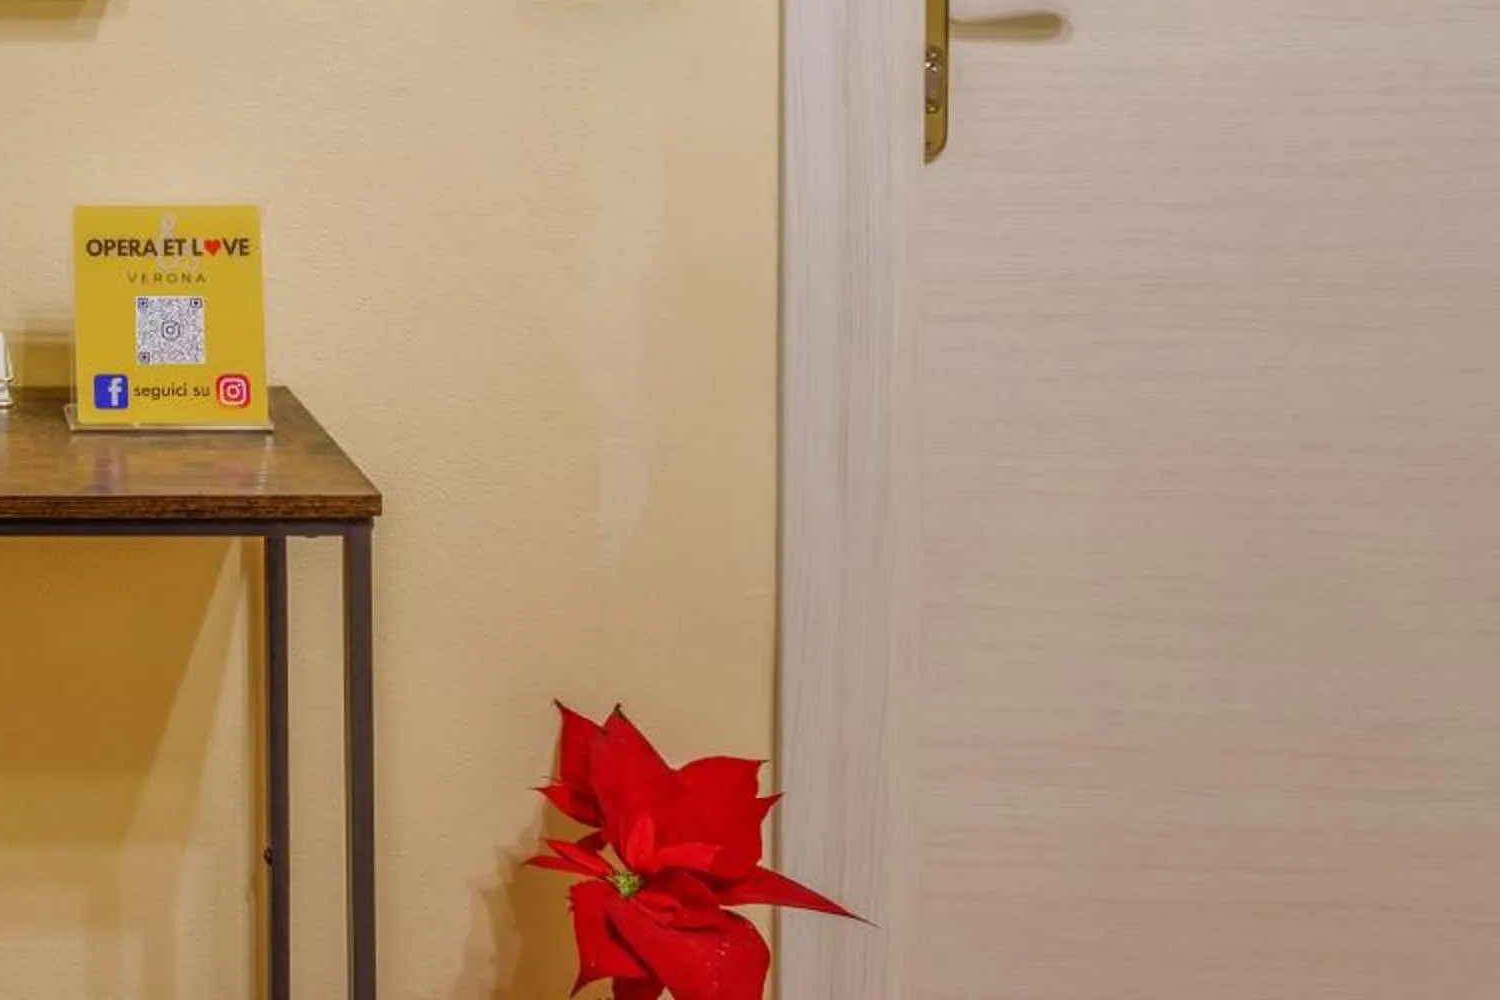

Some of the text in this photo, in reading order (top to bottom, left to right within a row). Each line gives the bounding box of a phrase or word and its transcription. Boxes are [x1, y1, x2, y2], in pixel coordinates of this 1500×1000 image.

[86, 238, 157, 257] OPERA
[163, 239, 186, 257] ET
[128, 273, 207, 285] VERONA
[133, 381, 187, 400] seguici
[192, 384, 211, 397] su
